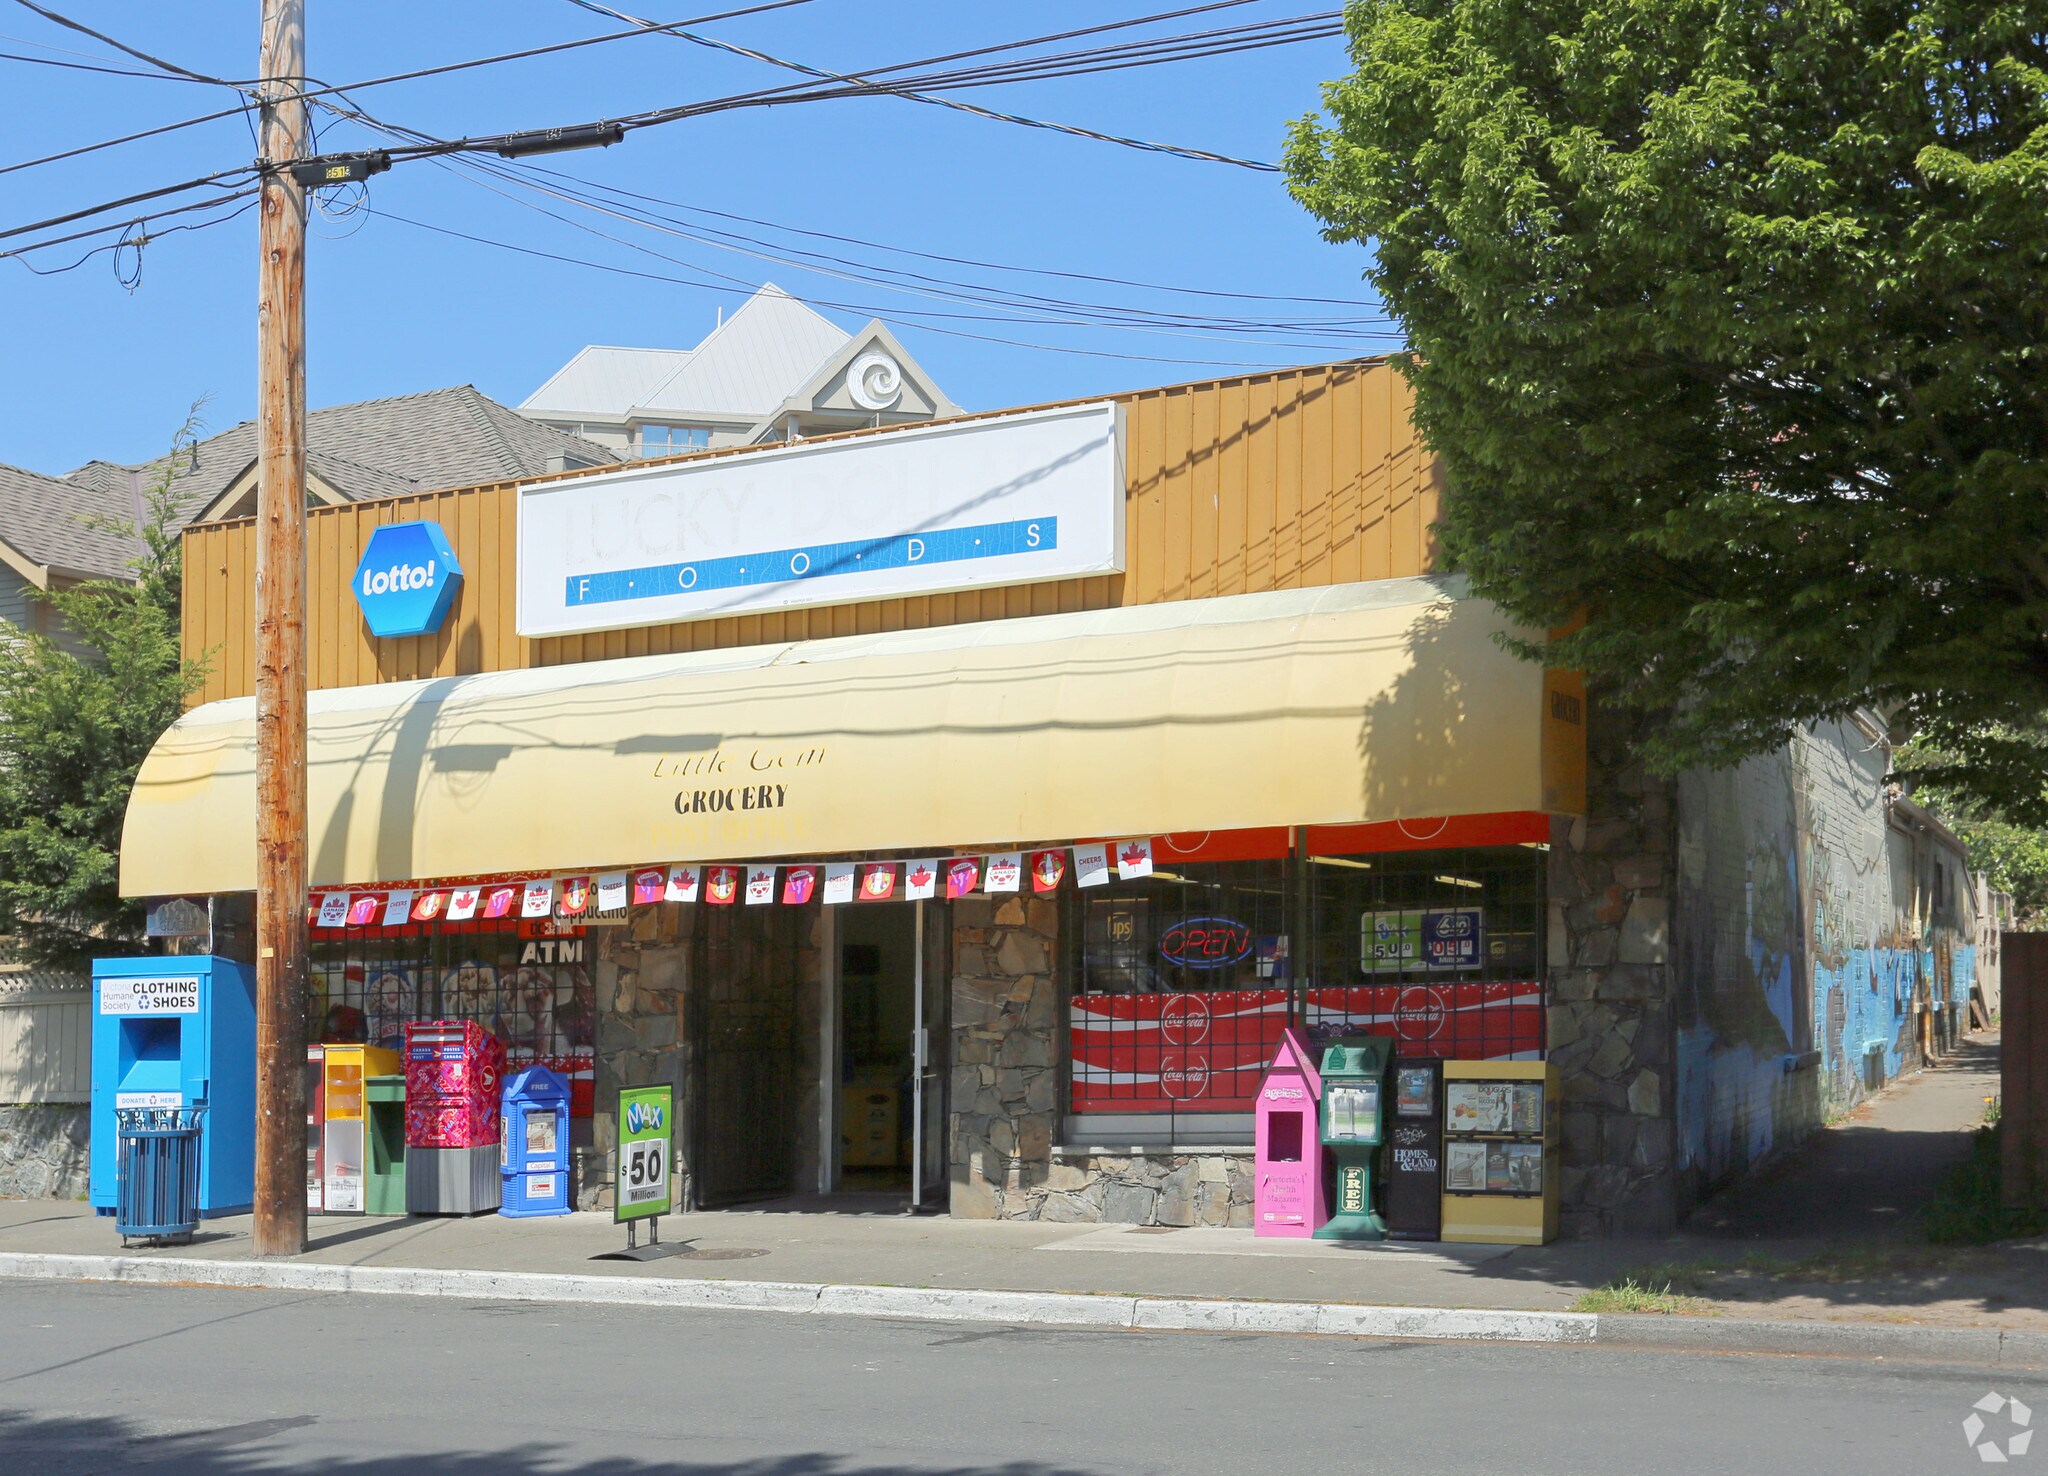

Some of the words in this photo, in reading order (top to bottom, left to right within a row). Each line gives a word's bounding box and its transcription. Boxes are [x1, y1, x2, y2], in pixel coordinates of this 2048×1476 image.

[674, 784, 788, 815] GROCERY
[1078, 855, 1102, 865] CHEERS
[989, 868, 1017, 876] CANADA
[1162, 929, 1250, 956] OPEN
[520, 940, 584, 964] ATM
[132, 982, 197, 995] CLOTHING
[102, 991, 135, 1001] Humane
[153, 996, 195, 1008] SHOES
[102, 1001, 131, 1012] Society
[1163, 1012, 1207, 1029] Coca-Cola
[1163, 1066, 1207, 1083] Coca-Cola
[1264, 1087, 1303, 1100] ageless
[626, 1102, 662, 1134] MAX
[1393, 1148, 1429, 1162] HOMES
[630, 1190, 656, 1202] Million
[1345, 1169, 1361, 1211] FREE
[1267, 1194, 1302, 1204] Magazine
